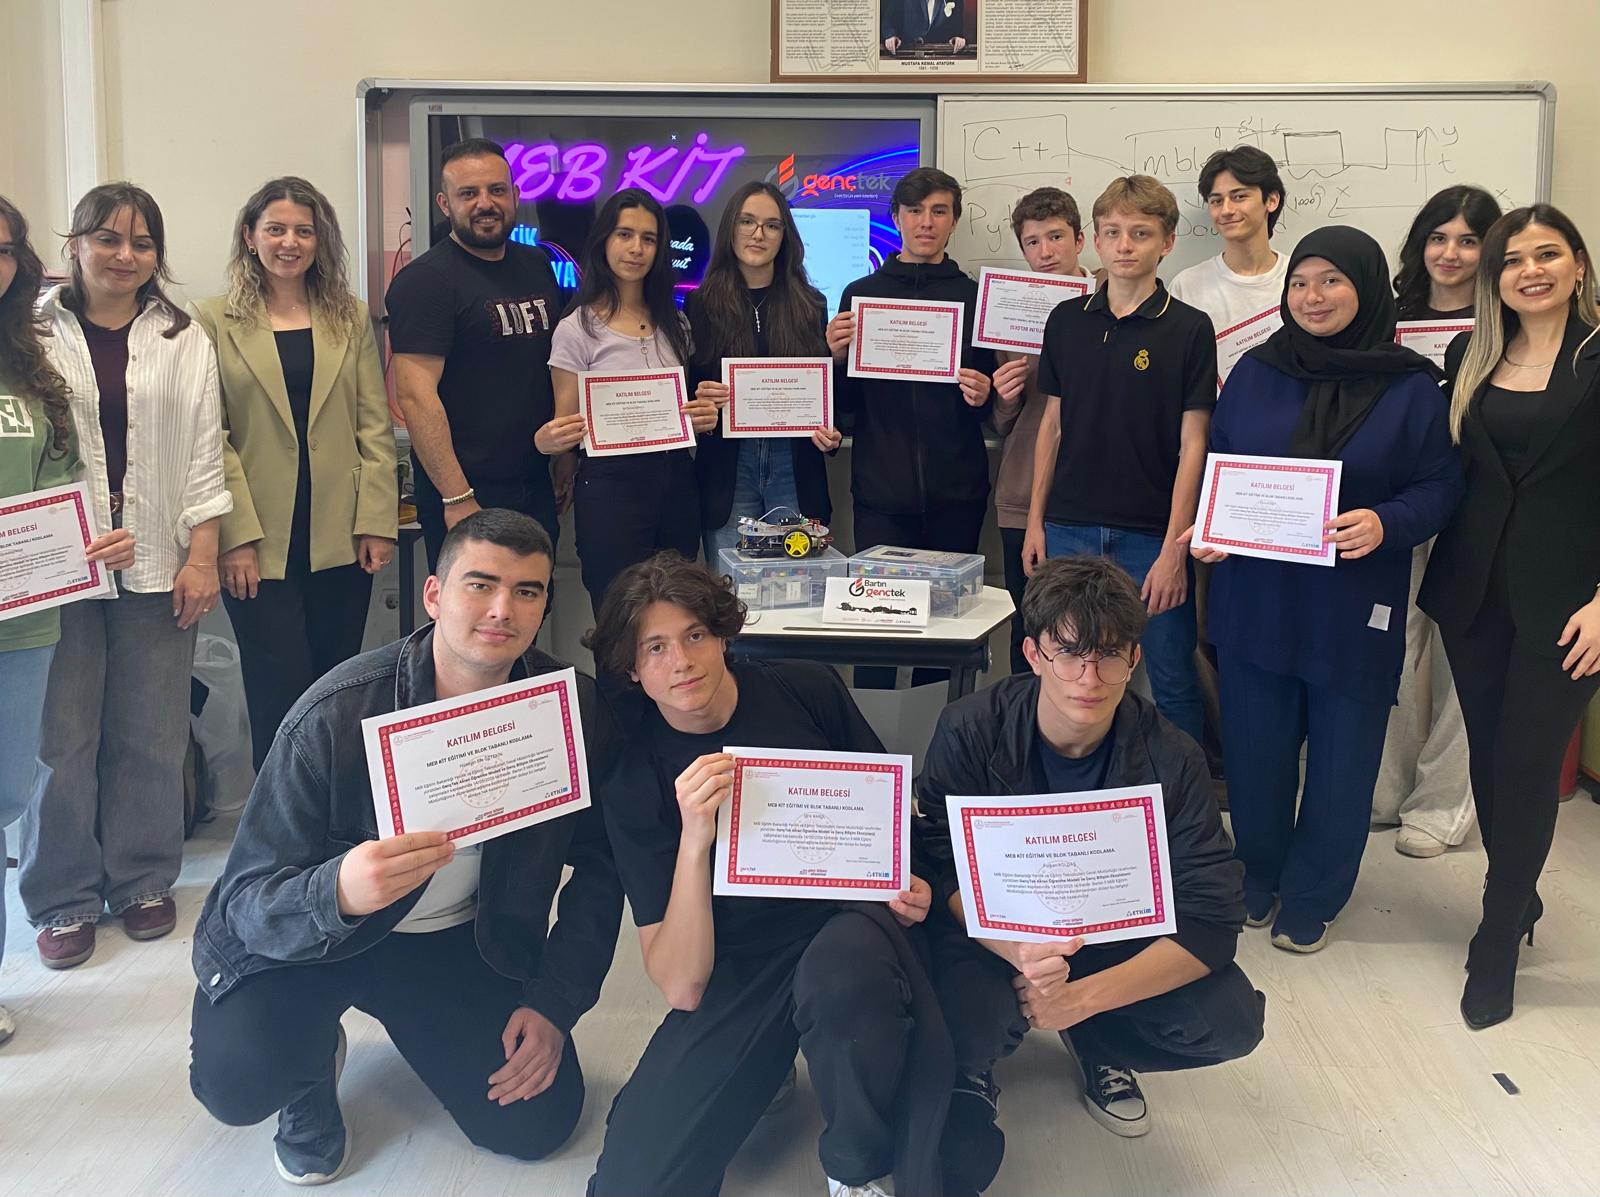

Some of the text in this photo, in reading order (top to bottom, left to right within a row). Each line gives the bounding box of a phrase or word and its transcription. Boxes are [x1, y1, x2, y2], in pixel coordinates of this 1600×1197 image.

[973, 126, 1049, 161] C++
[616, 133, 745, 202] KİT
[801, 173, 891, 197] gençtek
[495, 299, 549, 336] LOFT
[7, 522, 37, 537] BELGESİ
[864, 580, 887, 588] Bartın
[446, 731, 481, 748] KATILIM
[482, 719, 516, 738] BELGESİ
[467, 749, 474, 757] VE
[788, 787, 851, 798] KATILIM BELGESİ
[1025, 829, 1097, 845] KATILIM BELGESİ
